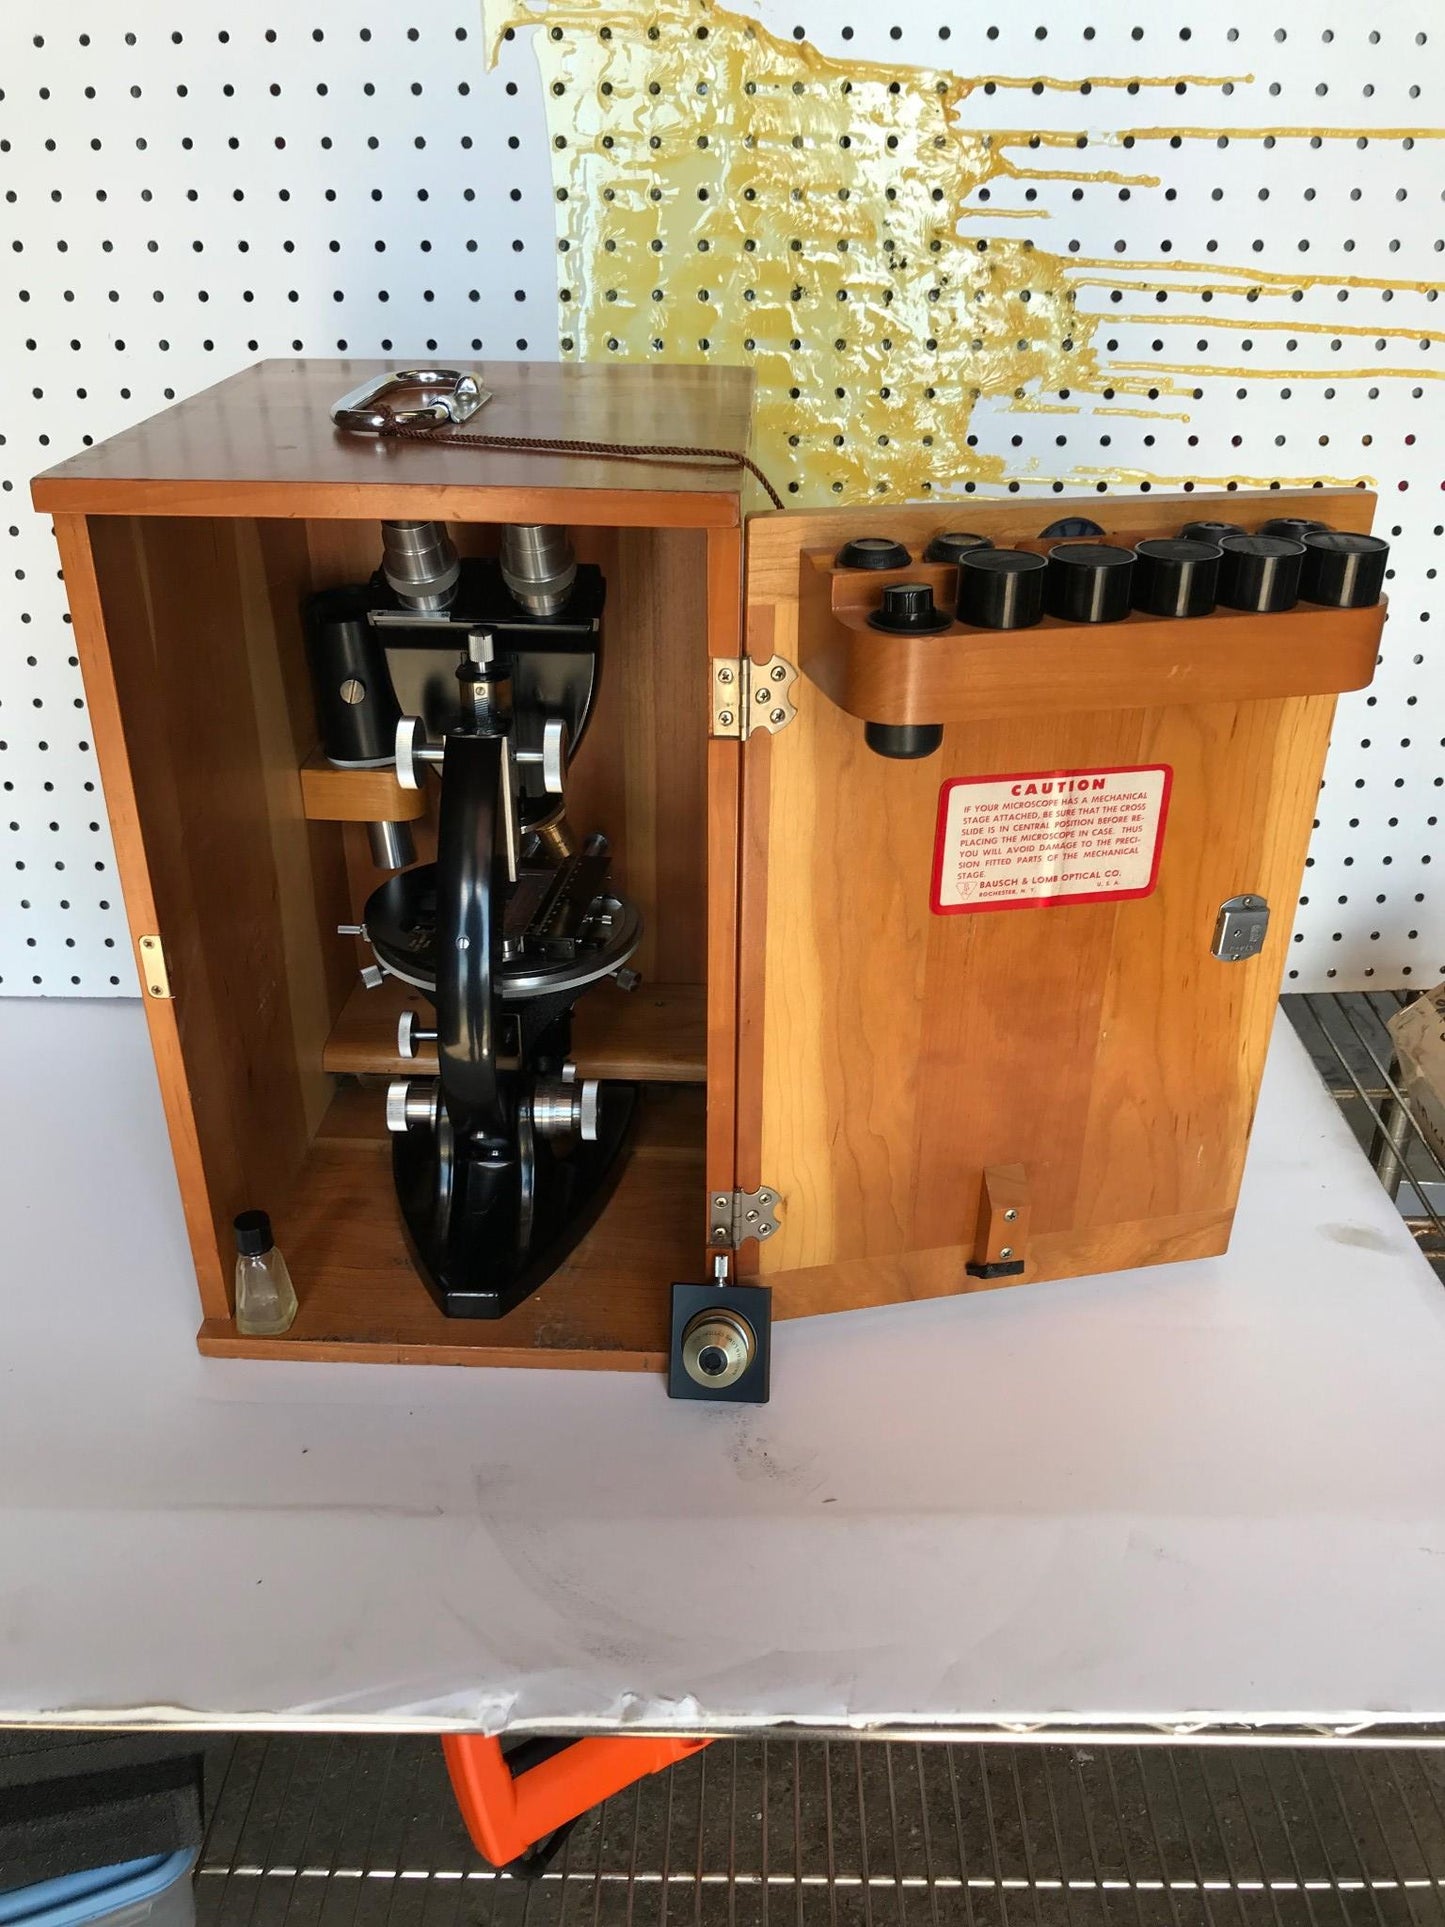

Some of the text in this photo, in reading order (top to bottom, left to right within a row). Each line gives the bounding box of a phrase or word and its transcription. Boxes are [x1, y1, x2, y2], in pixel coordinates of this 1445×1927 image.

[1011, 778, 1105, 796] CAUTION
[974, 804, 999, 812] YOUR
[1002, 799, 1058, 810] MICROSCOPE
[1061, 797, 1078, 805] HAS
[1091, 792, 1147, 803] MECHANICAL
[961, 827, 984, 836] SLIDE
[987, 826, 995, 834] IS
[1013, 822, 1049, 831] CENTRAL
[1054, 819, 1094, 828] POSITION
[1097, 815, 1128, 825] BEFORE
[1131, 814, 1144, 822] RE-
[963, 816, 990, 825] STAGE
[993, 812, 1040, 822] ATTACHED,
[1056, 808, 1076, 817] SURE
[1079, 806, 1100, 815] THAT
[1102, 805, 1118, 813] THE
[1120, 803, 1146, 812] CROSS
[960, 837, 998, 847] PLACING
[1002, 835, 1017, 843] THE
[1020, 831, 1075, 842] MICROSCOPE
[1121, 825, 1143, 833] THUS
[960, 849, 978, 858] YOU
[983, 848, 1002, 856] WILL
[1006, 844, 1035, 854] AVOID
[1039, 841, 1077, 851] DAMAGE
[1115, 836, 1141, 845] PRECI-
[958, 861, 980, 869] SION
[985, 858, 1011, 867] FITTED
[1016, 855, 1042, 864] PARTS
[1062, 852, 1078, 860] THE
[1083, 847, 1139, 858] MECHANICAL
[979, 879, 1018, 888] BAUSCH
[1021, 877, 1028, 885] &
[1032, 875, 1058, 884] LOMB
[1061, 872, 1100, 881] OPTICAL
[1104, 869, 1121, 878] CO.
